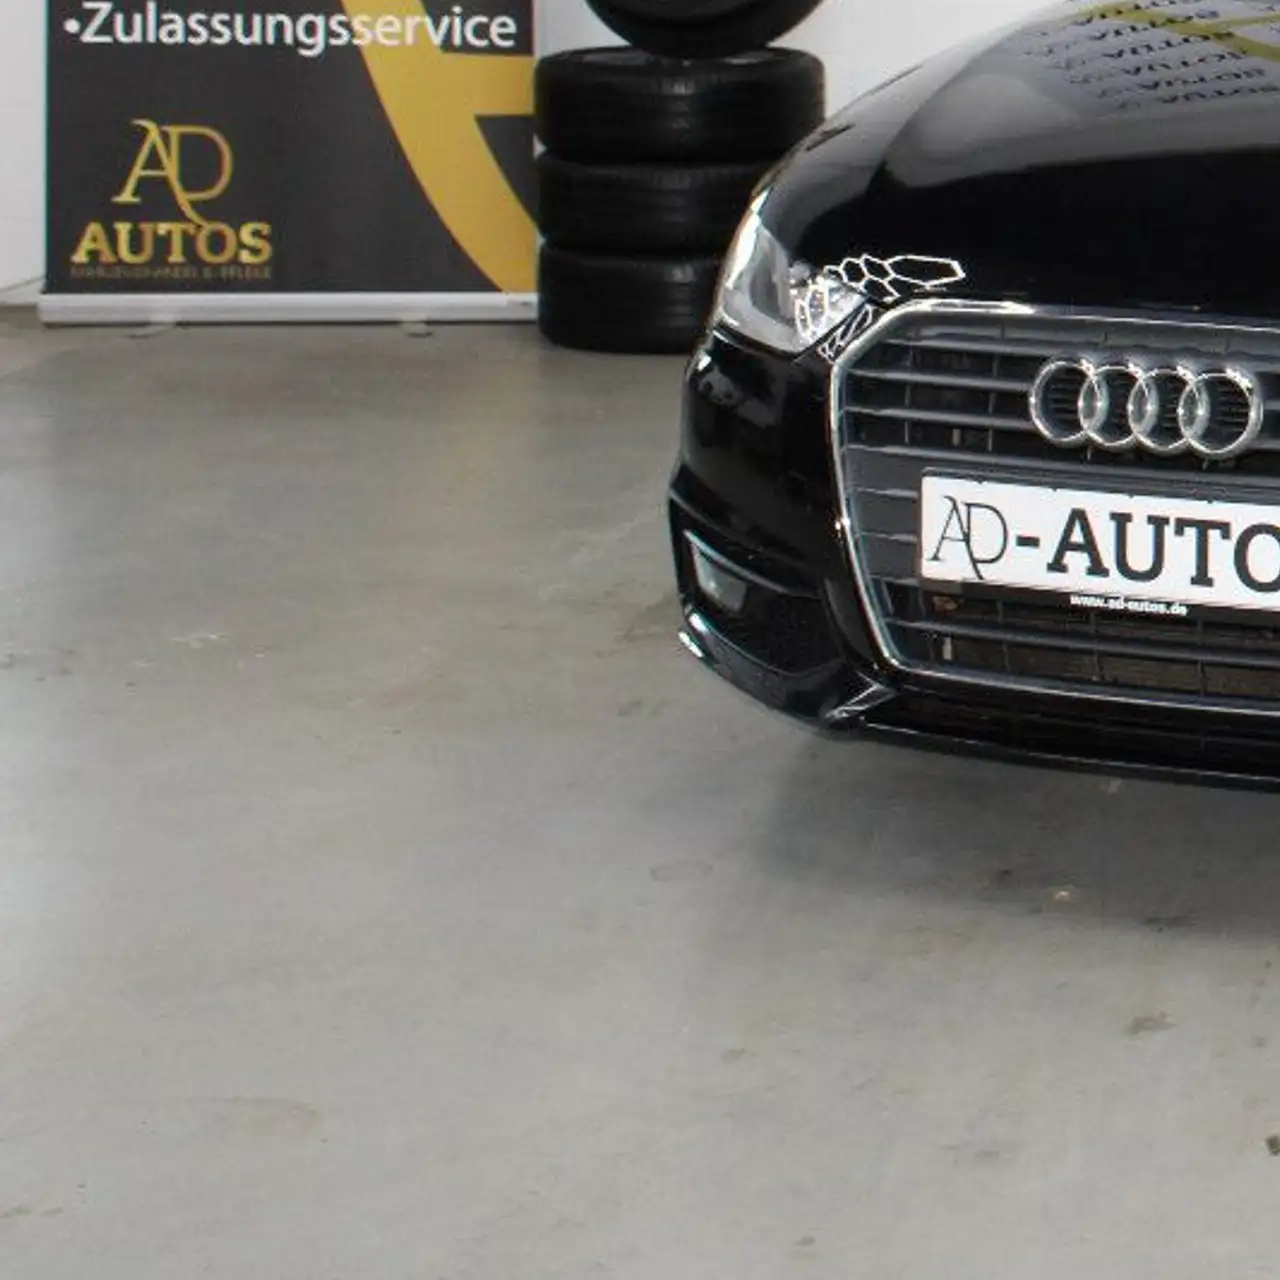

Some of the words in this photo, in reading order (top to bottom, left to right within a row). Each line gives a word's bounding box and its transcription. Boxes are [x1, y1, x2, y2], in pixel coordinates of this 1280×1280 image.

[79, 1, 517, 57] Zulassungsservice
[112, 119, 233, 226] AD
[71, 221, 272, 264] AUTOS
[1070, 594, 1188, 616] www.ad-autos.de
